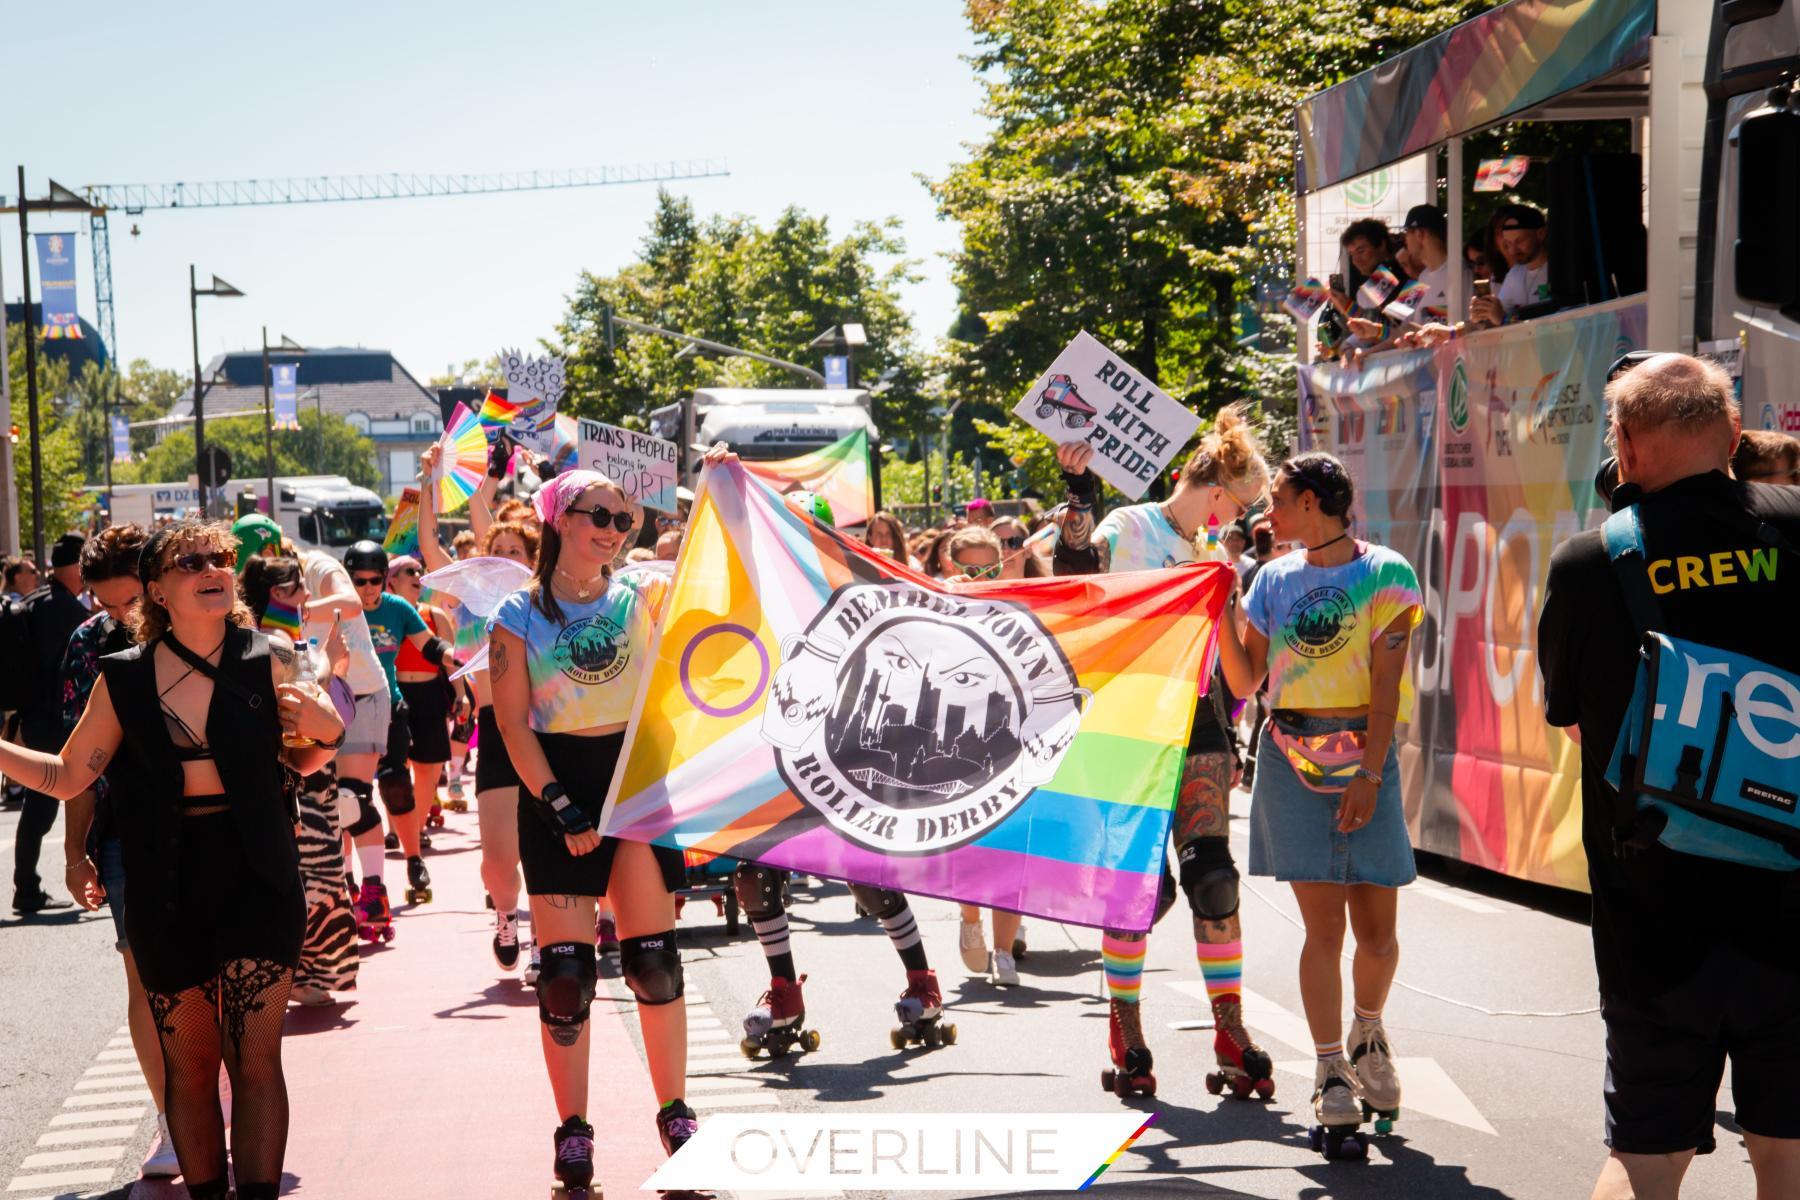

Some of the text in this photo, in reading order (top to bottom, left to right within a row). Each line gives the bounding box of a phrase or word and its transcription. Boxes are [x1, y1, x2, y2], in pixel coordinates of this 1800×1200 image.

[1095, 359, 1155, 414] ROLL
[581, 421, 625, 449] TRANS
[1084, 423, 1159, 483] PRIDE
[1105, 402, 1171, 457] WITH
[175, 489, 190, 501] DZ
[1647, 548, 1778, 595] CREW
[836, 590, 1055, 682] BEMBEL TOWN
[792, 751, 1023, 844] ROLLER DERBY
[1746, 785, 1793, 806] FREITAG
